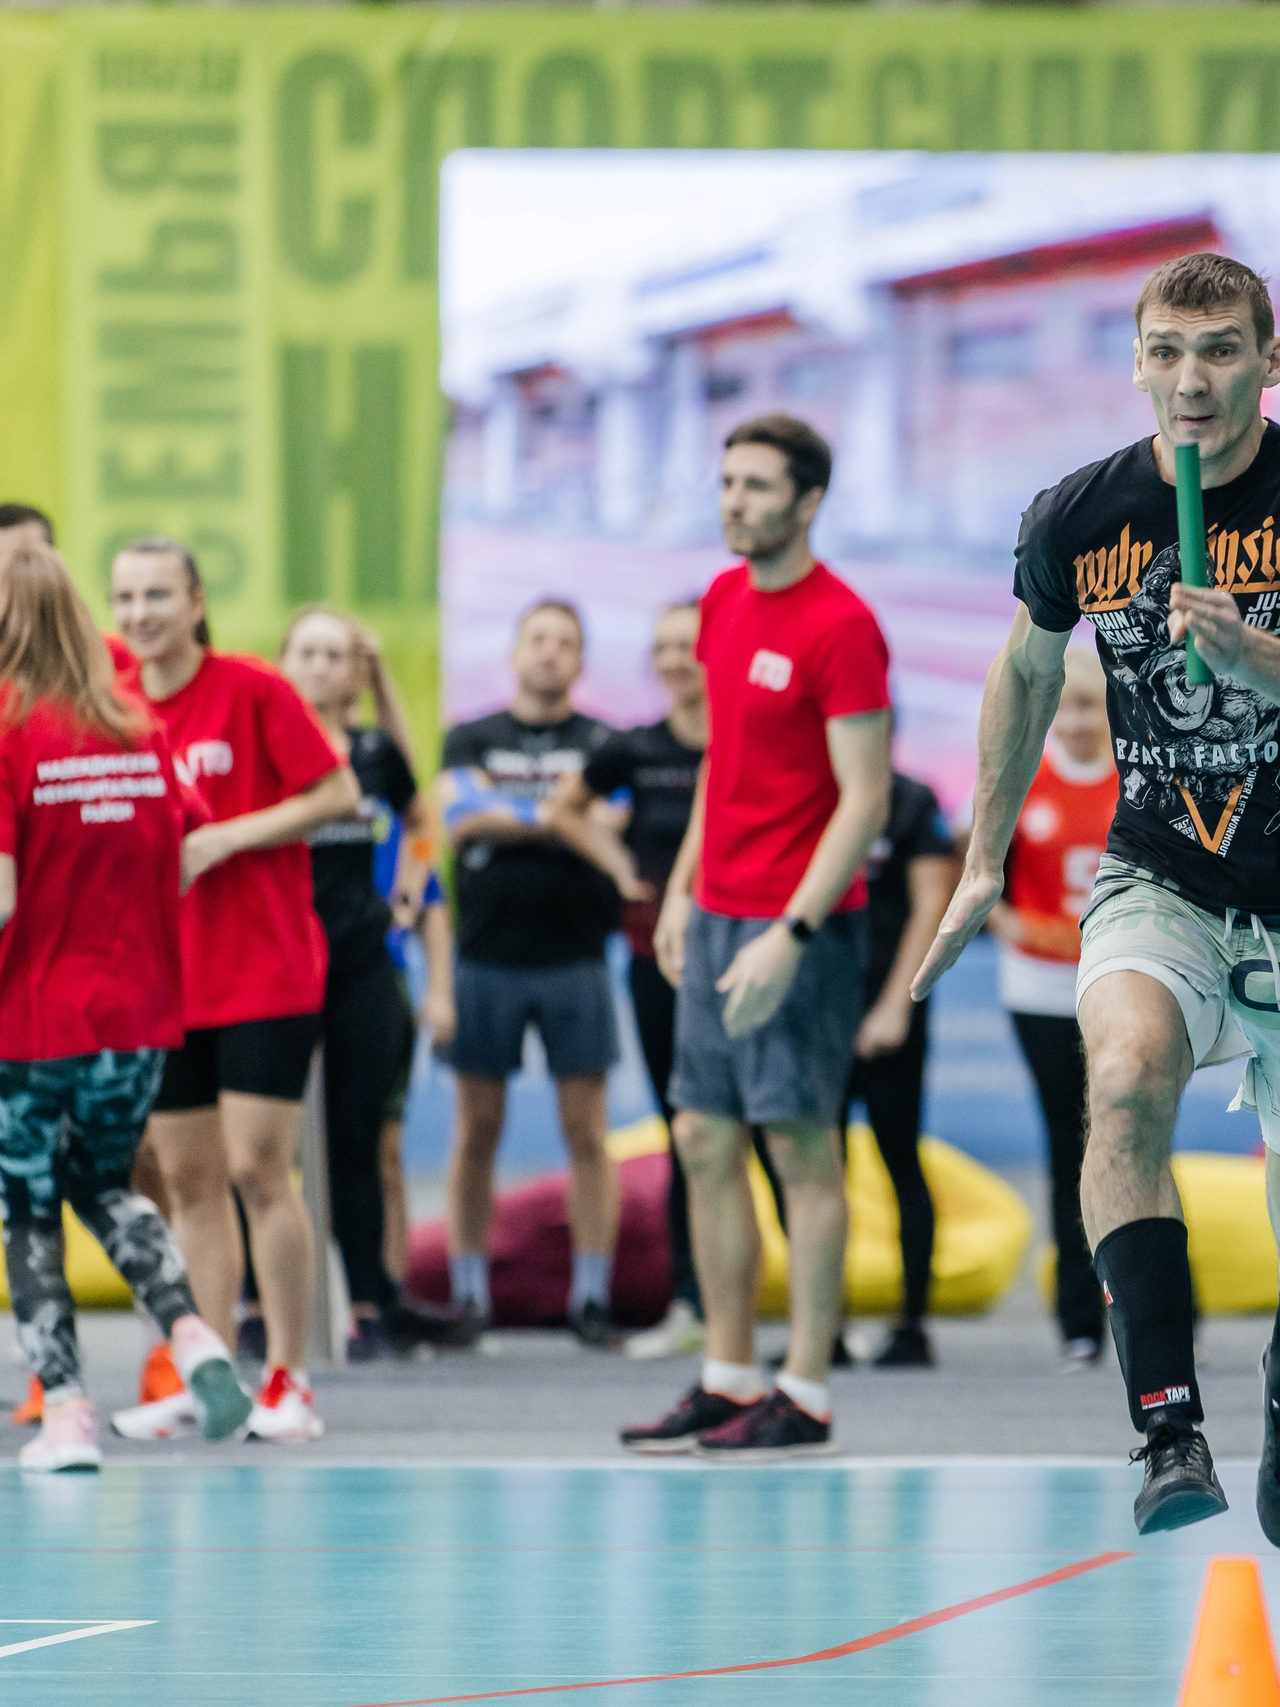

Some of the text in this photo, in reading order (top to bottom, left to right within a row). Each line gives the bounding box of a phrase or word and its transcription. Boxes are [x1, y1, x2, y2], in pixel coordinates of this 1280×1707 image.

[1086, 610, 1130, 630] TRAIN
[1245, 611, 1272, 630] DO
[1116, 737, 1176, 768] BEAST
[1235, 795, 1248, 814] LIFE
